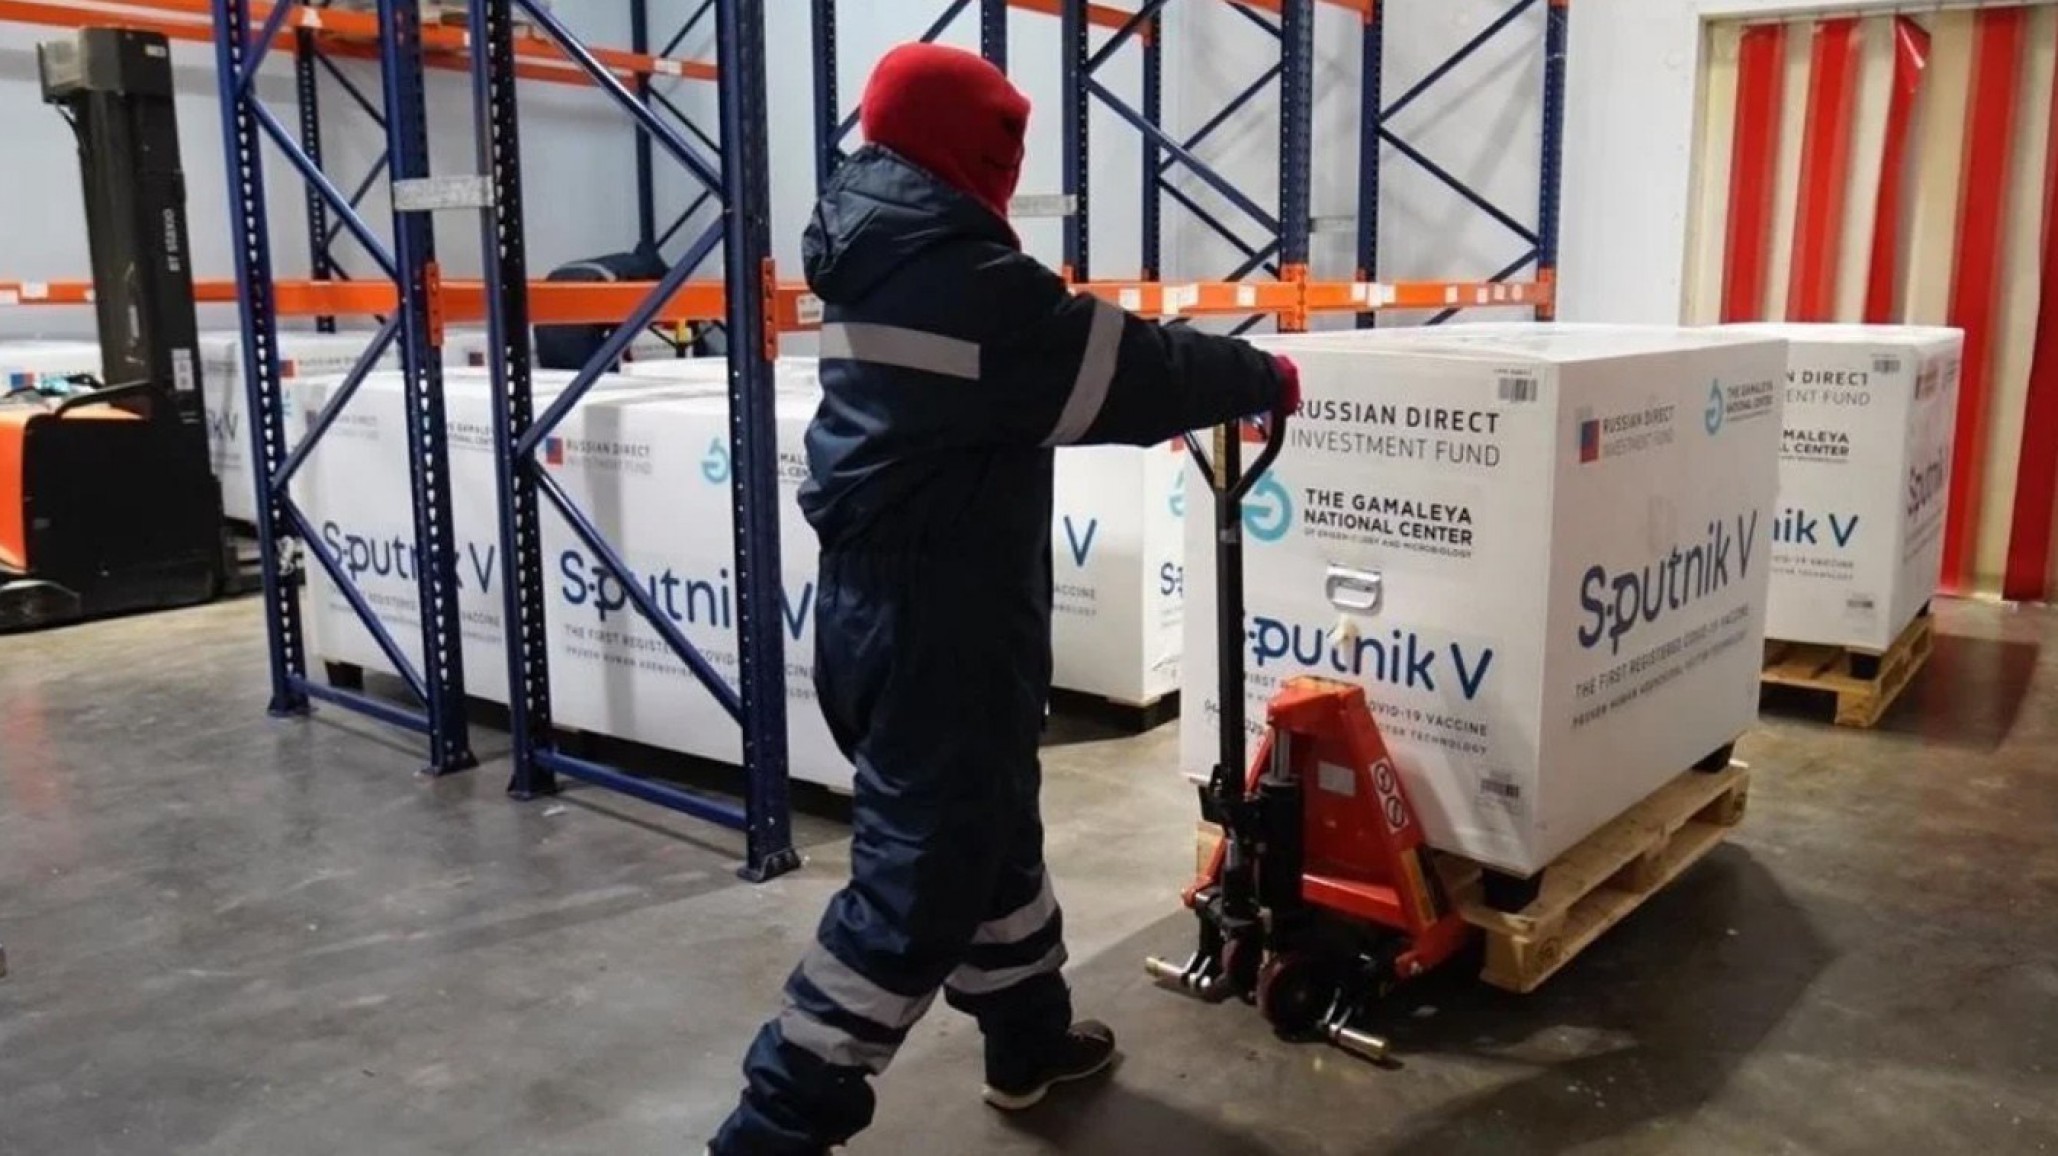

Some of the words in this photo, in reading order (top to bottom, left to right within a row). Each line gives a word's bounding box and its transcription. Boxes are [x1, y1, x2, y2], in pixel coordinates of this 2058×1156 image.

[1802, 371, 1868, 387] DIRECT
[1293, 399, 1396, 425] RUSSIAN
[1406, 406, 1501, 434] DIRECT
[1291, 428, 1427, 460] INVESTMENT
[1435, 440, 1501, 467] FUND
[1782, 429, 1850, 444] MALEYA
[1305, 487, 1345, 509] THE
[1351, 493, 1473, 526] GAMALEYA
[1063, 513, 1098, 568] V
[1304, 508, 1394, 536] NATIONAL
[1398, 521, 1473, 547] CENTER
[1828, 512, 1859, 548] V
[468, 540, 496, 594] V
[1578, 520, 1731, 657] Sputnik
[1738, 509, 1758, 579] V
[559, 549, 732, 630] Sputni
[779, 581, 814, 641] V
[1053, 582, 1096, 601] ACCINE
[1248, 616, 1436, 692] putnik
[1450, 641, 1494, 701] V
[1368, 699, 1421, 722] OVID-19
[1425, 711, 1488, 737] VACCINE
